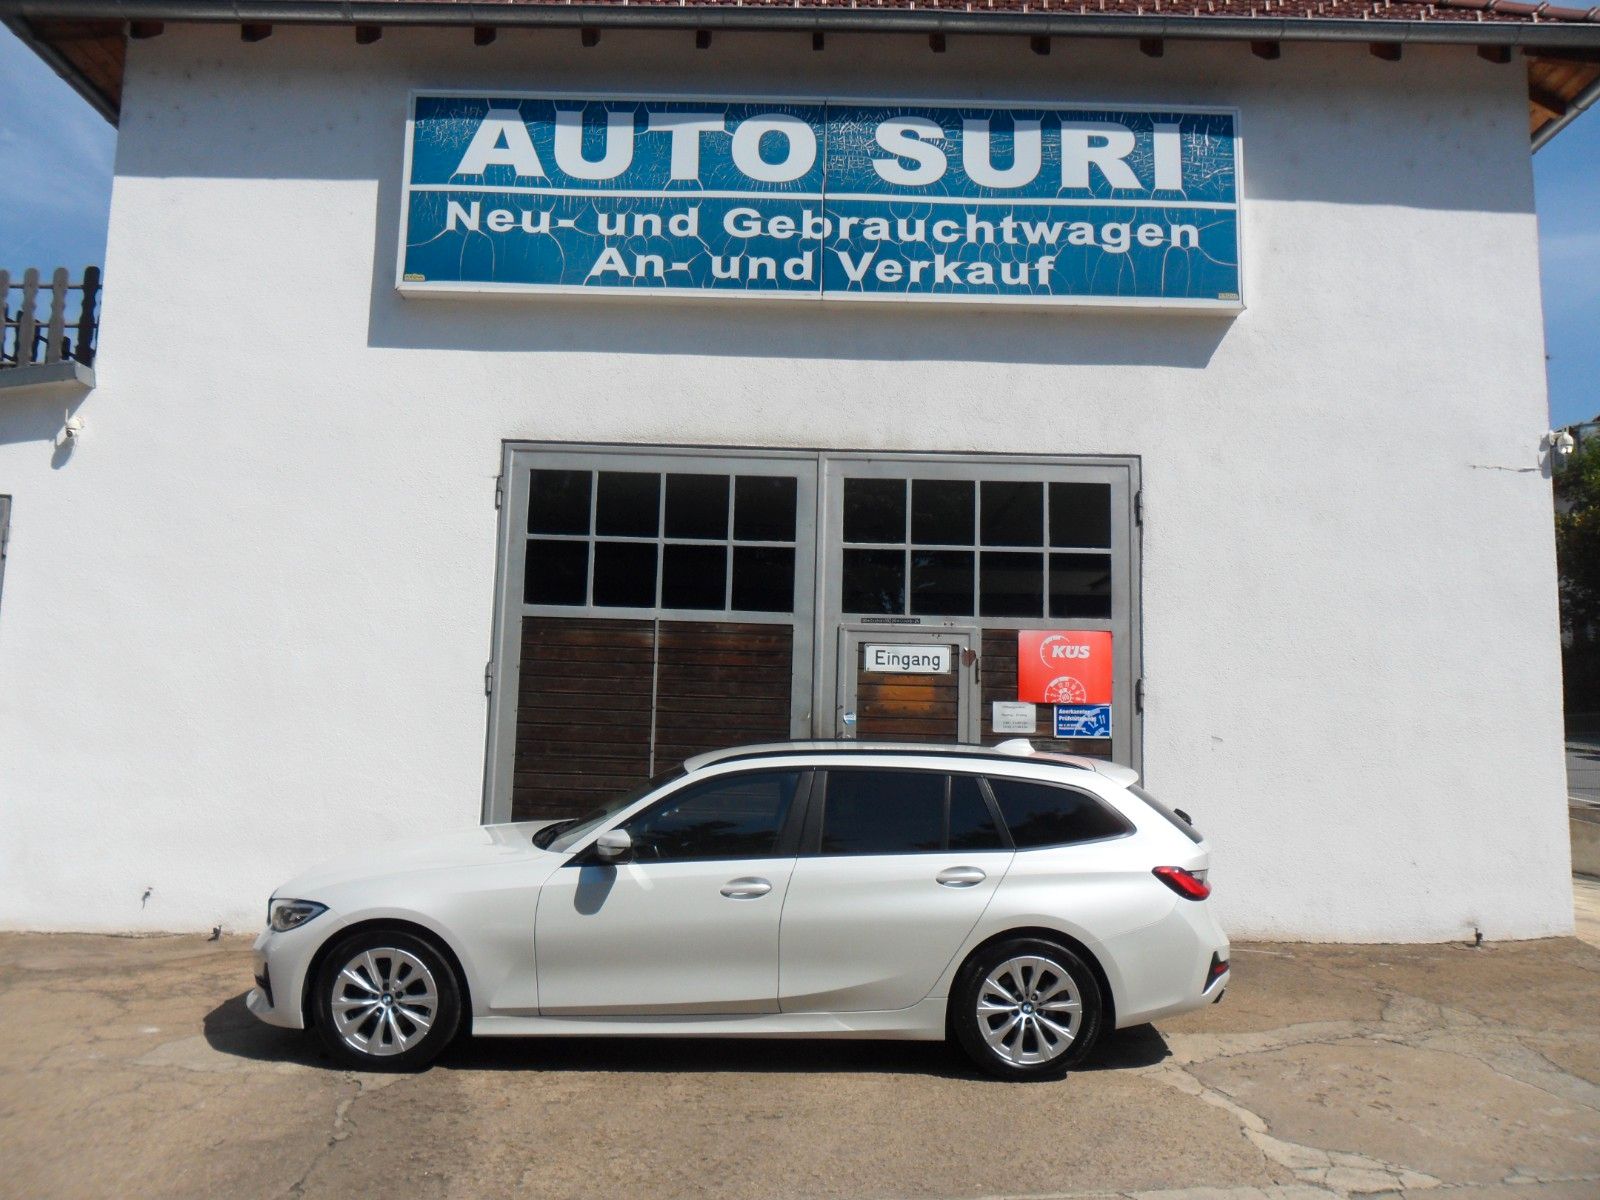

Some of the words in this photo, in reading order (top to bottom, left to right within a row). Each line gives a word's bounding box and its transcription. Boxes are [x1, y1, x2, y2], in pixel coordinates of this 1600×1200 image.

[455, 108, 817, 182] AUTO
[872, 116, 1183, 190] SURI
[446, 201, 575, 233] Neu-
[597, 208, 699, 237] und
[723, 208, 1199, 253] Gebrauchtwagen
[590, 247, 690, 277] An-
[711, 251, 813, 281] und
[838, 251, 1055, 285] Verkauf
[875, 650, 941, 671] Eingang
[1052, 645, 1090, 659] KÜS
